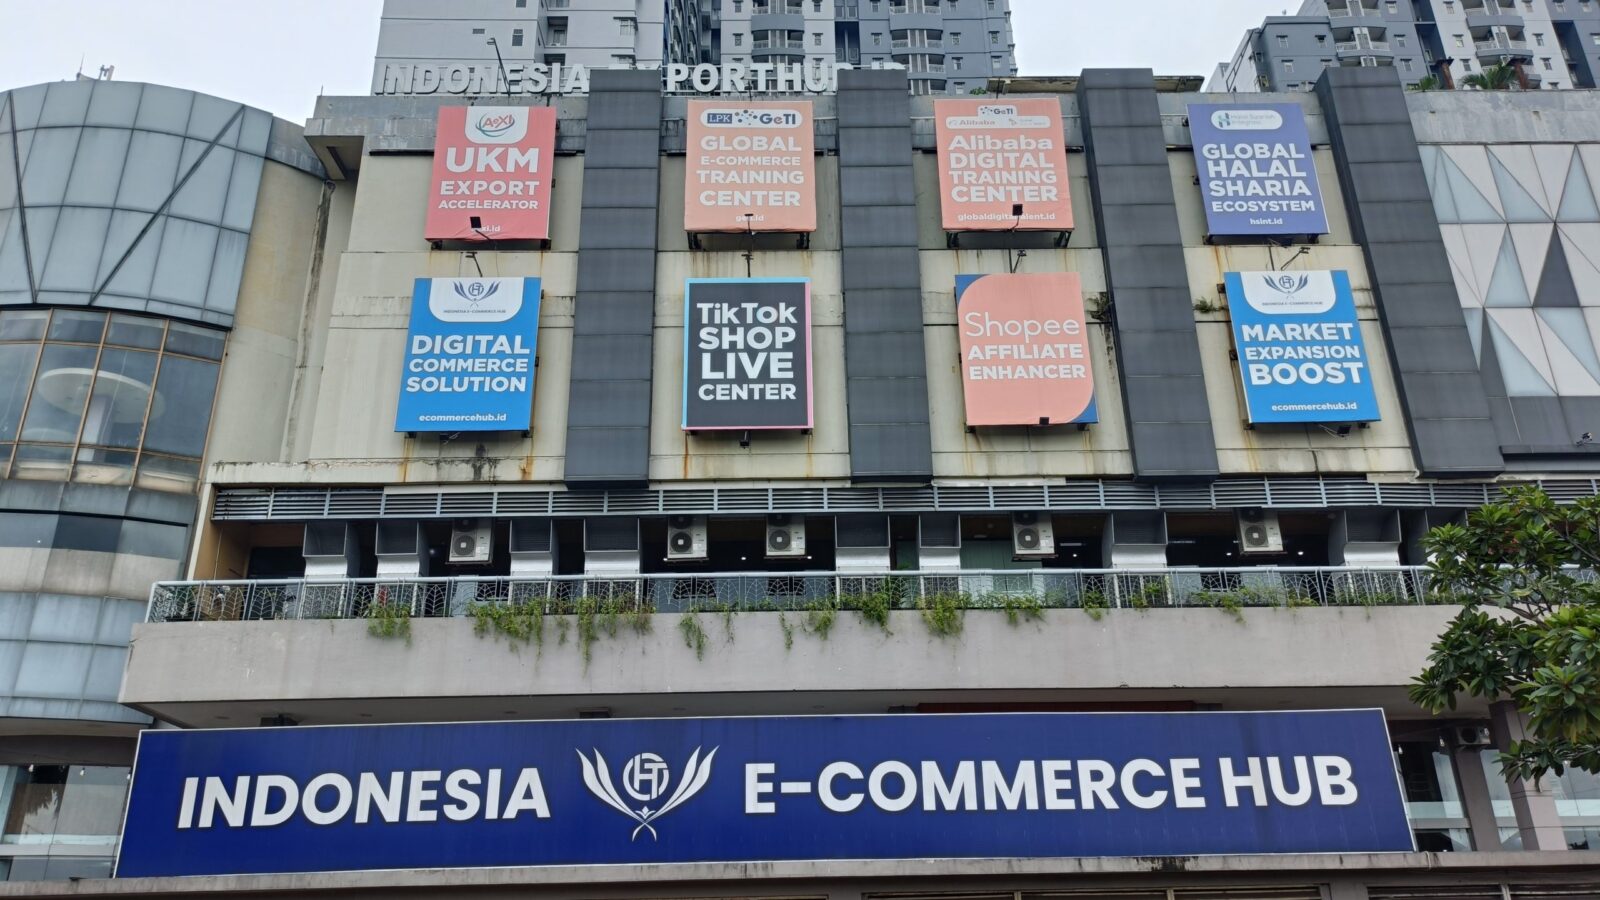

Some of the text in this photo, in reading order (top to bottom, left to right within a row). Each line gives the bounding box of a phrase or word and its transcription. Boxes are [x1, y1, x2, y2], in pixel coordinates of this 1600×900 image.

[374, 63, 589, 95] INDONESIA
[709, 113, 796, 124] LPK GeTI
[700, 136, 802, 151] GLOBAL
[948, 135, 1052, 150] Alibaba
[1202, 143, 1305, 159] GLOBAL
[446, 147, 539, 173] UKM
[701, 156, 800, 165] E-COMMERCE
[950, 152, 1054, 169] DIGITAL
[1207, 159, 1307, 178] HALAL
[696, 170, 804, 184] TRAINING
[949, 170, 1057, 184] TRAINING
[440, 181, 539, 195] EXPORT
[951, 186, 1058, 202] CENTER
[1209, 180, 1312, 197] SHARIA
[438, 200, 538, 209] ACCELERATOR
[700, 190, 800, 206] CENTER
[1212, 200, 1315, 212] ECOSYSTEM
[696, 302, 798, 324] TikTok
[965, 311, 1080, 343] Shopee
[1241, 323, 1353, 341] MARKET
[411, 335, 530, 354] DIGITAL
[698, 326, 796, 350] SHOP
[968, 343, 1084, 360] AFFILIATE
[1245, 345, 1360, 360] EXPANSION
[409, 358, 528, 372] COMMERCE
[701, 352, 794, 379] LIVE
[969, 364, 1086, 380] ENHANCER
[1248, 362, 1363, 385] BOOST
[406, 376, 527, 392] SOLUTION
[698, 384, 797, 400] CENTER
[1271, 402, 1357, 411] ecommercehub.id
[419, 413, 507, 422] ecommercehub.id
[177, 767, 551, 829] INDONESIA
[744, 757, 1206, 814] E-COMMERCE
[1218, 755, 1359, 808] HUB
